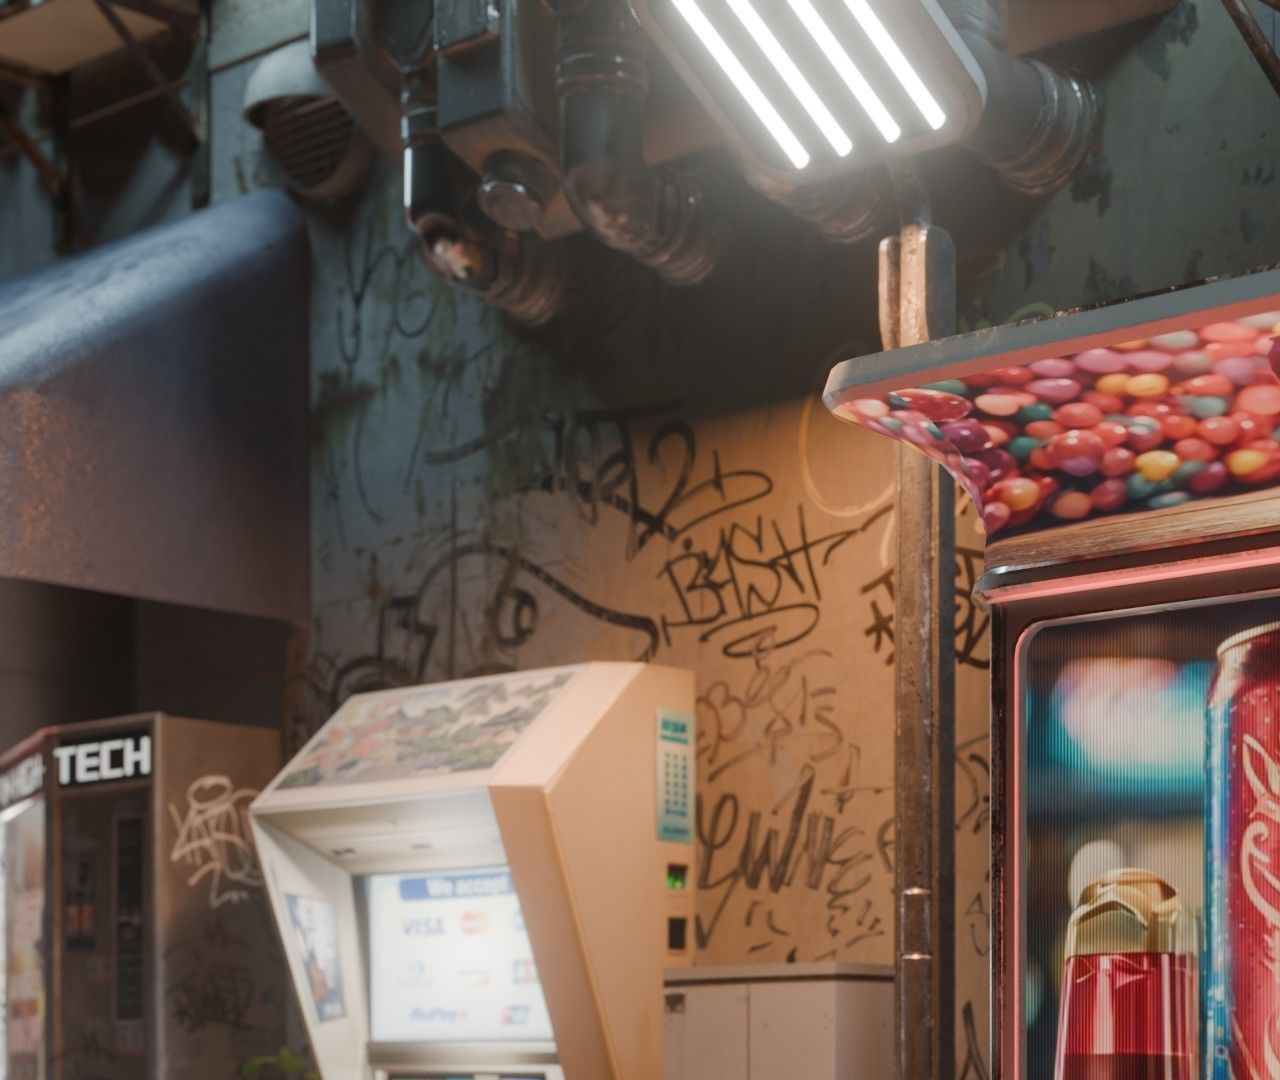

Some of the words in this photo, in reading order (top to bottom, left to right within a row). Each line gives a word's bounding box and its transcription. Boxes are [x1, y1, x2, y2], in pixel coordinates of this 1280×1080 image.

[53, 735, 152, 785] TECH
[426, 877, 454, 898] We
[402, 917, 444, 936] VISA
